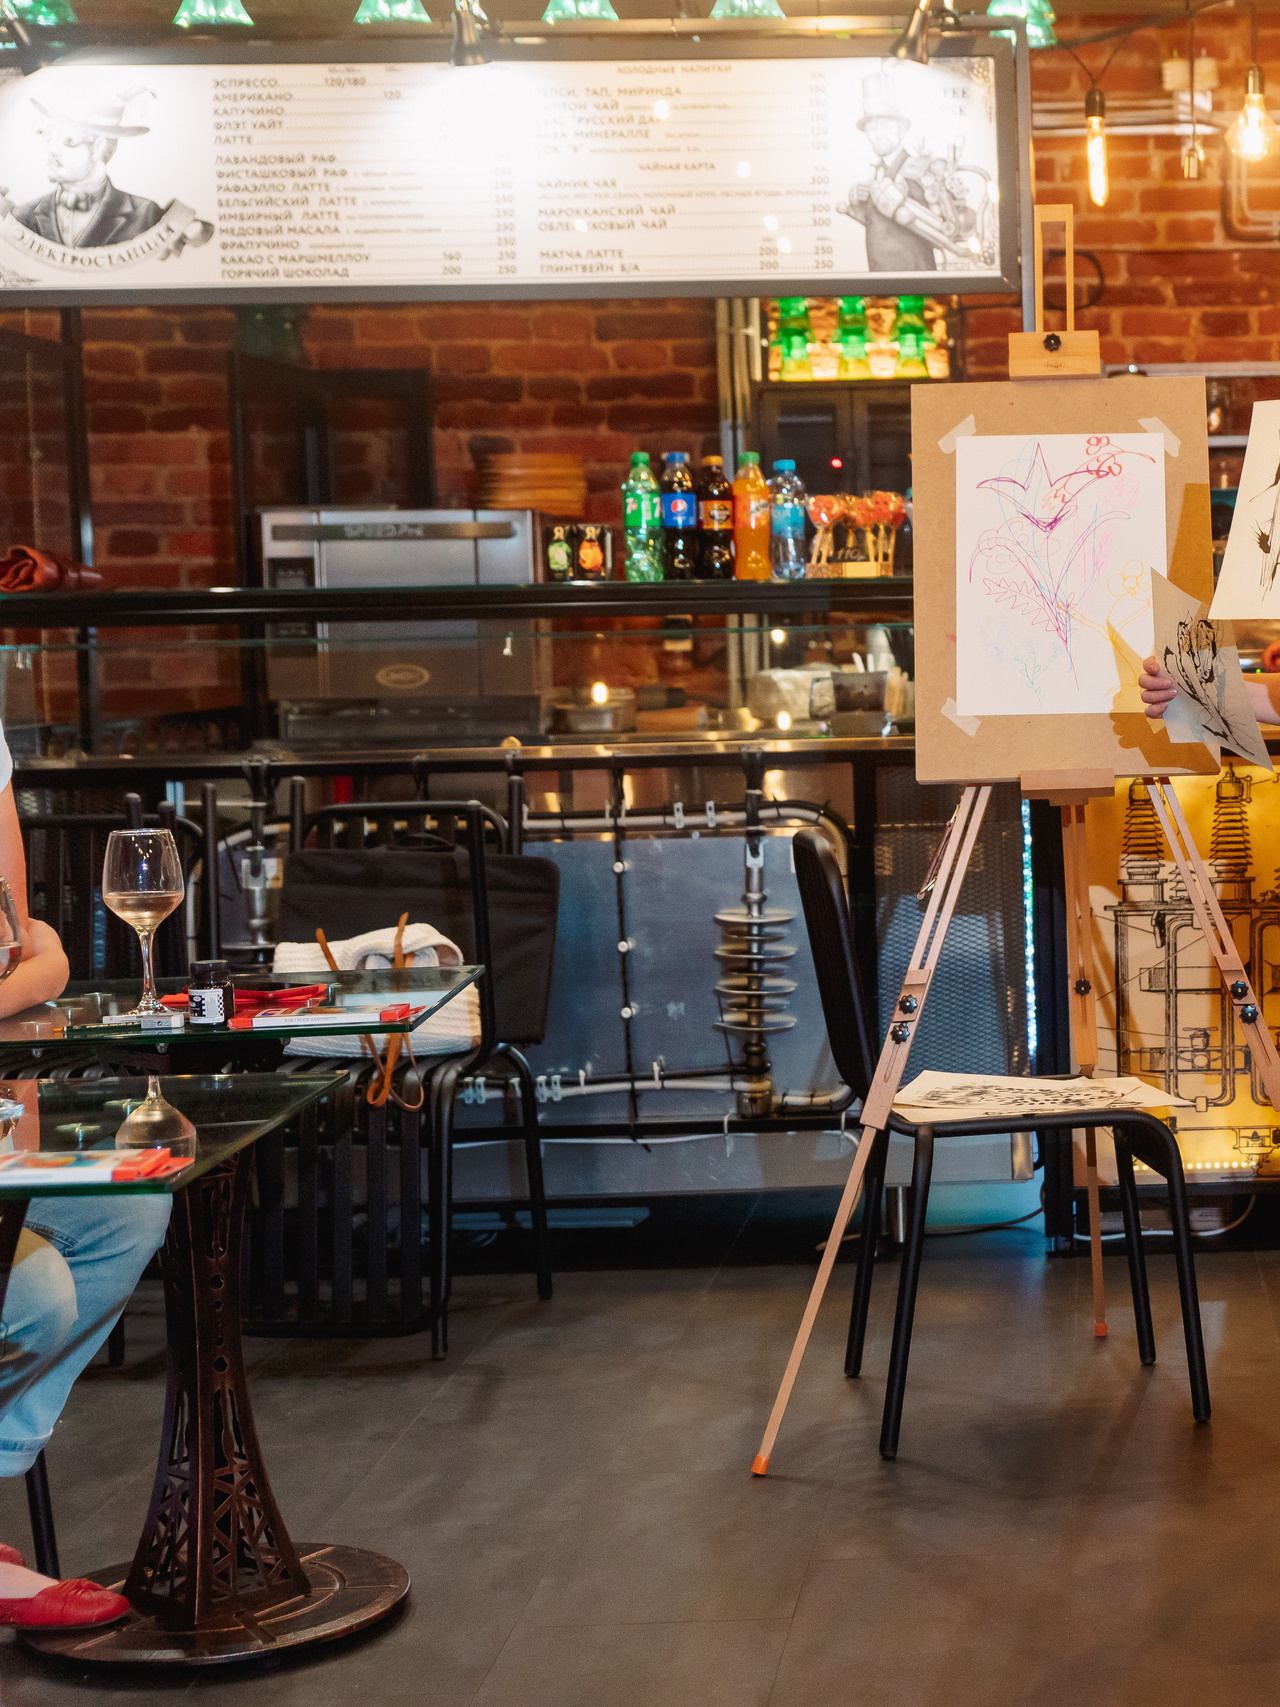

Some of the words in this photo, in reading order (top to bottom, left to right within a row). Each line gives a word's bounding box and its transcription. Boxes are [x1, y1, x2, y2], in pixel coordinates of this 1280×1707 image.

[617, 66, 676, 76] ХОЛОДНЫЕ
[681, 65, 732, 75] НАПИТКИ
[212, 78, 278, 90] ЭСПРЕССО
[324, 76, 366, 89] 120/180
[212, 91, 293, 103] АМЕРИКАНО
[383, 90, 402, 100] 120
[616, 86, 683, 98] МИРИНДА
[212, 105, 285, 118] КАПУЧИНО
[593, 99, 620, 111] ЧАЙ
[213, 120, 247, 131] ФЛЭТ
[250, 118, 284, 131] УАЙТ
[213, 134, 253, 146] ЛАТТЕ
[574, 128, 651, 140] МИНЕРАЛЛЕ
[214, 152, 305, 165] ЛАВАНДОВЫЙ
[311, 152, 337, 164] РАФ
[637, 161, 681, 171] ЧАЙНАЯ
[684, 161, 717, 171] КАРТА
[215, 167, 317, 179] ФИСТАШКОВЫЙ
[323, 168, 348, 178] РАФ
[216, 182, 286, 194] РАФАЭЛЛО
[291, 182, 331, 193] ЛАТТЕ
[536, 178, 590, 189] ЧАЙНИК
[593, 178, 618, 189] ЧАЯ
[811, 175, 830, 185] 300
[217, 195, 310, 208] БЕЛЬГИЙСКИЙ
[318, 196, 358, 207] ЛАТТЕ
[218, 210, 293, 222] ИМБИРНЫЙ
[301, 211, 341, 221] ЛАТТЕ
[537, 204, 644, 217] МАРОККАНСКИЙ
[650, 203, 676, 215] ЧАЙ
[811, 203, 831, 213] 300
[219, 224, 284, 237] МЕДОВЫЙ
[287, 225, 341, 236] МАСАЛА
[495, 222, 516, 232] 250
[538, 219, 636, 232] ОБЛЕХОВЫЙ
[641, 218, 668, 230] ЧАЙ
[812, 217, 832, 227] 300
[219, 239, 300, 250] ФРАПУЧИНО
[496, 236, 516, 247] 250
[220, 254, 264, 265] КАКАО
[278, 252, 371, 264] МАРШМЕЛЛОУ
[540, 249, 583, 260] МАТЧА
[585, 248, 624, 259] ЛАТТЕ
[759, 246, 779, 256] 200
[814, 245, 834, 256] 250
[221, 266, 280, 279] ГОРЯЧИЙ
[283, 266, 350, 279] ШОКОЛАД
[442, 265, 462, 276] 200
[497, 264, 517, 275] 250
[540, 262, 614, 274] ГЛИНТВЕЙН
[619, 262, 641, 273] Б/А
[759, 260, 779, 270] 200
[814, 259, 834, 269] 250
